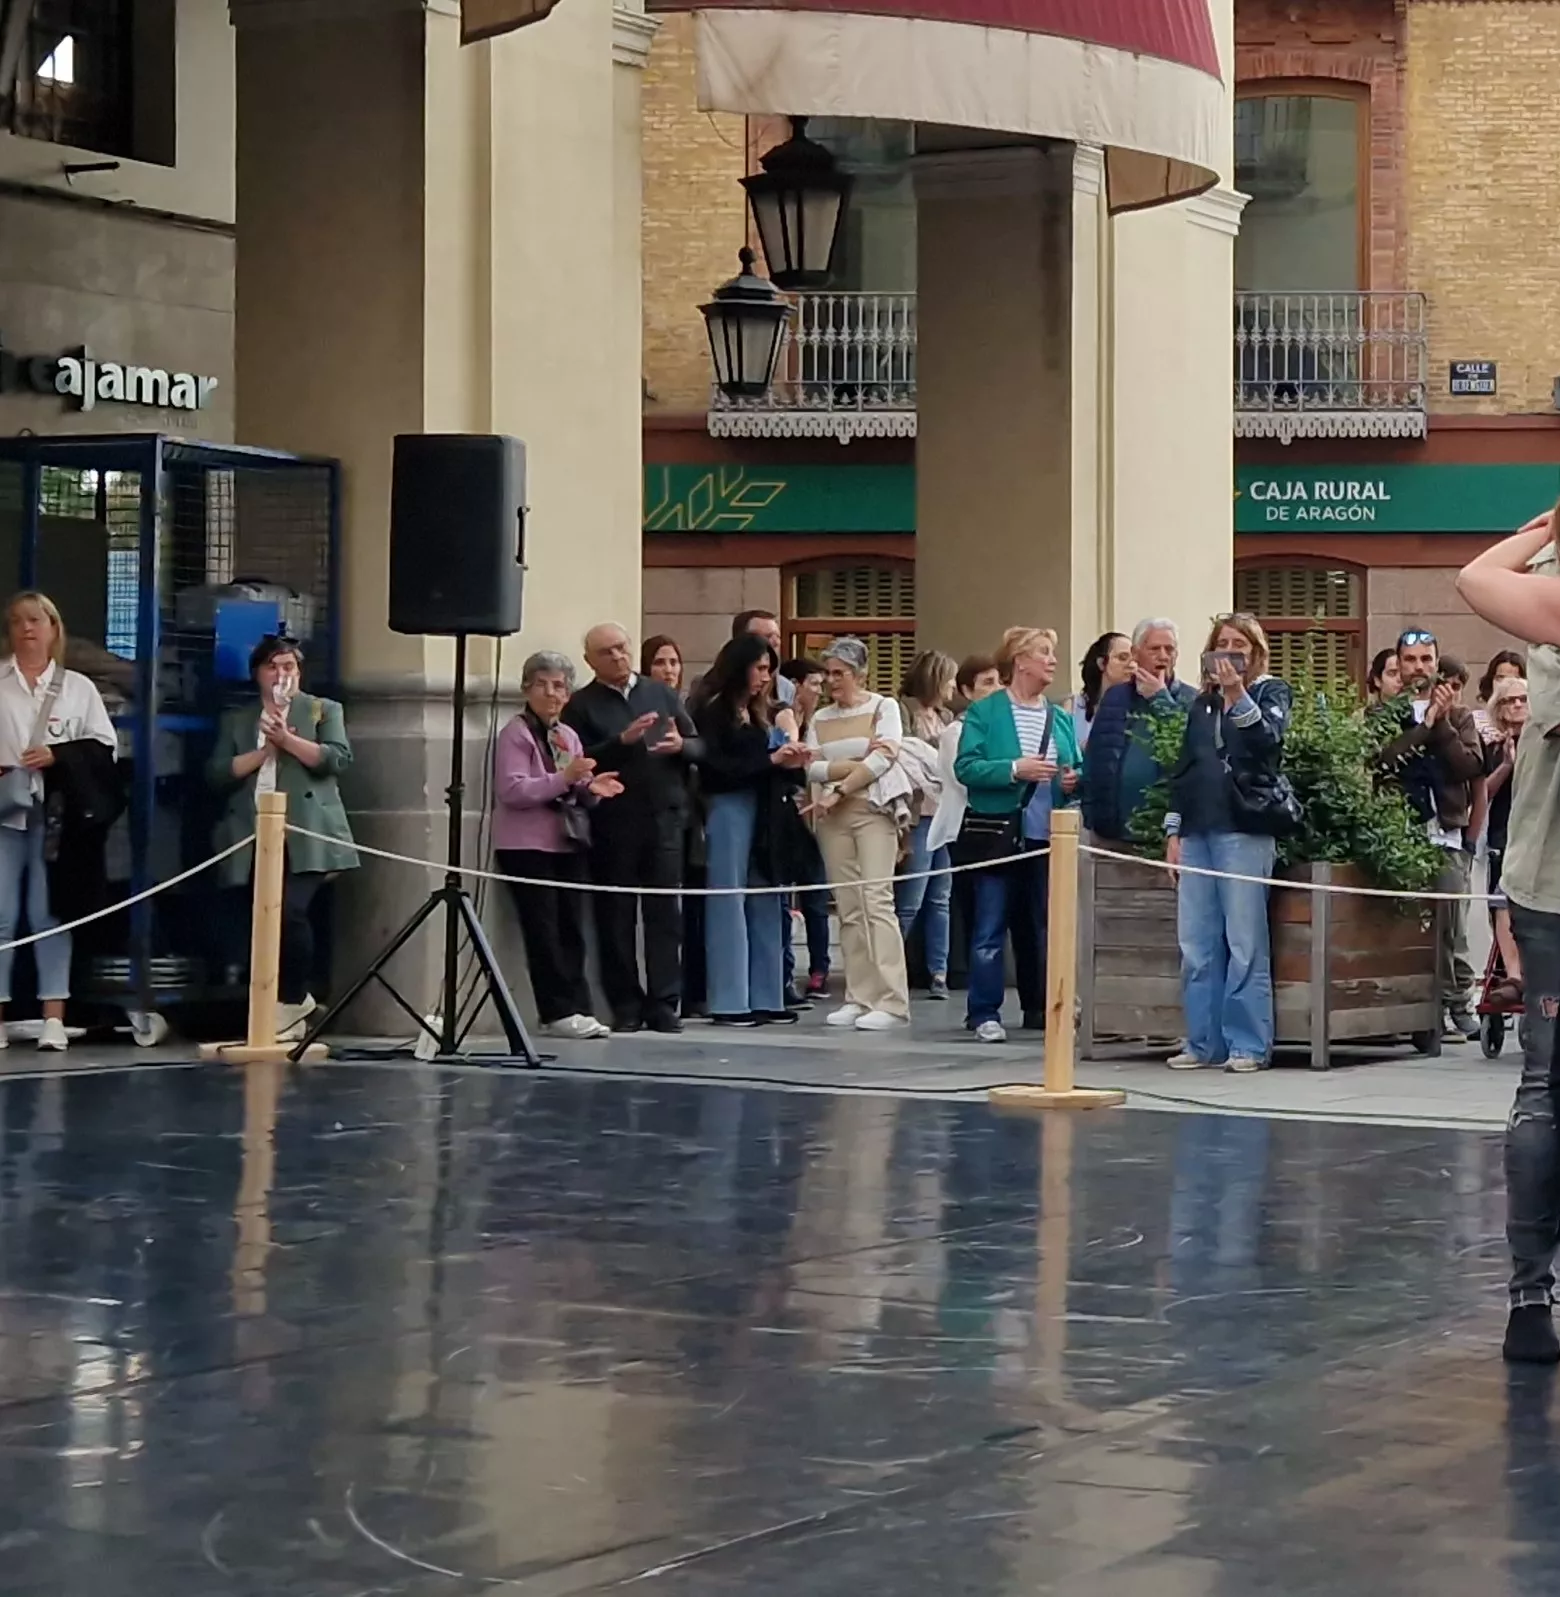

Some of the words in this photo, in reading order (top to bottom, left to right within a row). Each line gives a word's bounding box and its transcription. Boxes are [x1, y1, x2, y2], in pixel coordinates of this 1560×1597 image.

[1456, 363, 1490, 373] CALLE
[1249, 481, 1308, 500] CAJA
[1314, 481, 1391, 500] RURAL
[1266, 506, 1290, 521] DE
[1296, 502, 1376, 521] ARAGÓN
